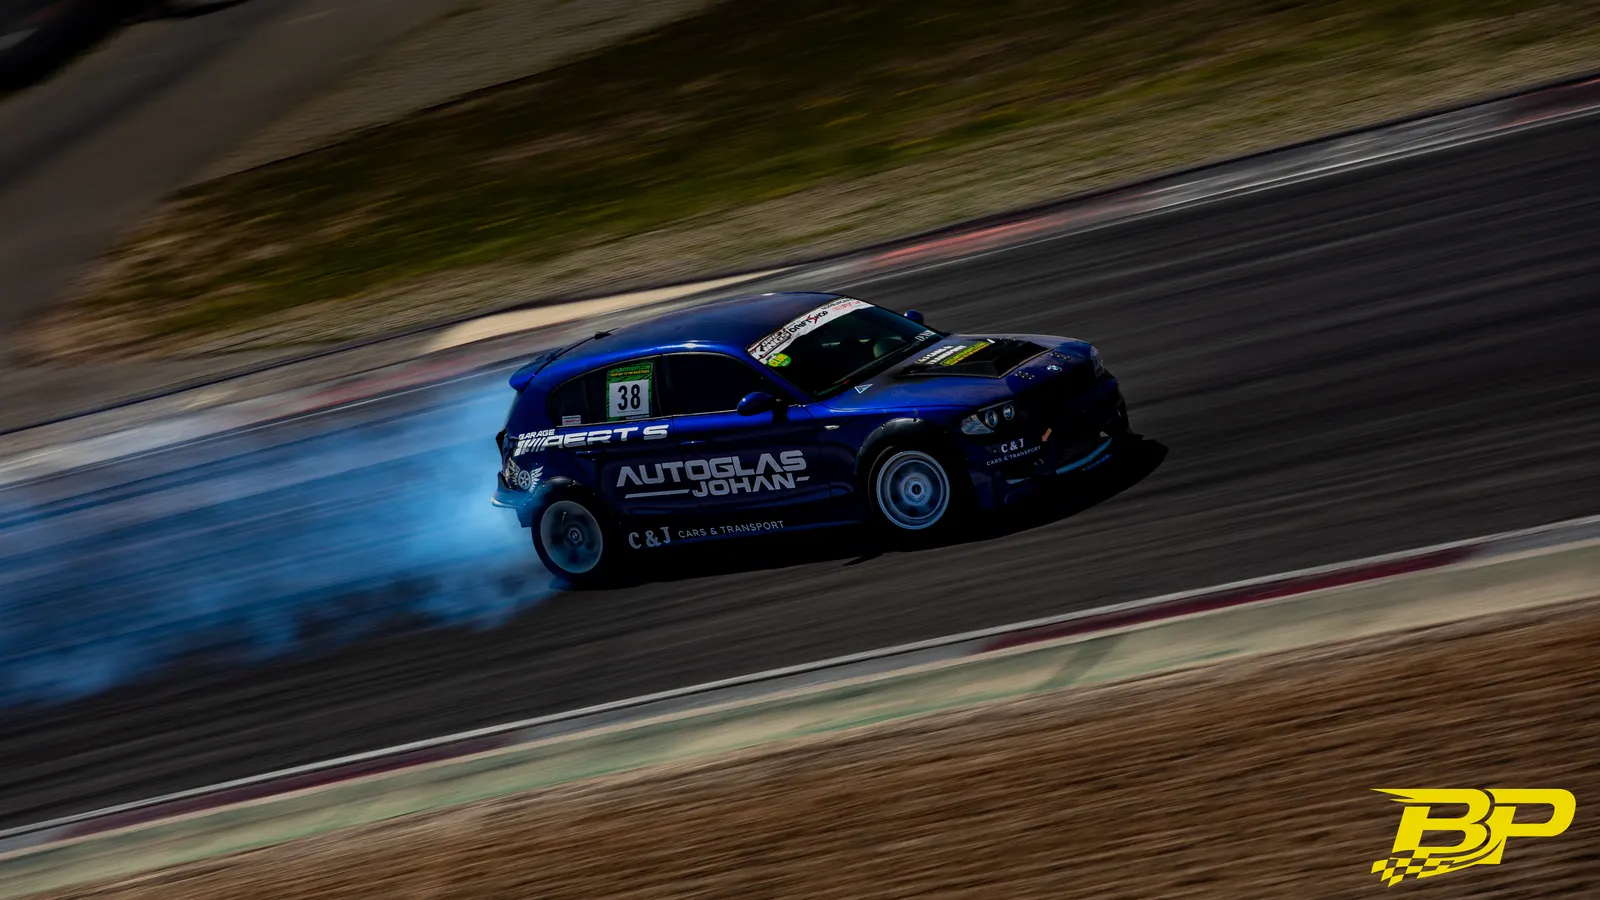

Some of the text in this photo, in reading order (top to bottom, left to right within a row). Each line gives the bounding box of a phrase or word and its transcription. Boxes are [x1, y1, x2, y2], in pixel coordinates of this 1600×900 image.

[751, 332, 789, 359] KINGS
[617, 384, 641, 410] 38
[518, 429, 556, 441] GARAGE
[616, 449, 807, 488] AUTOGLAS
[986, 457, 1003, 467] CARS
[1009, 445, 1042, 460] TRANSPORT
[692, 473, 797, 498] JOHAN
[678, 527, 707, 539] CARS
[710, 527, 718, 537] &
[720, 520, 785, 534] TRANSPORT
